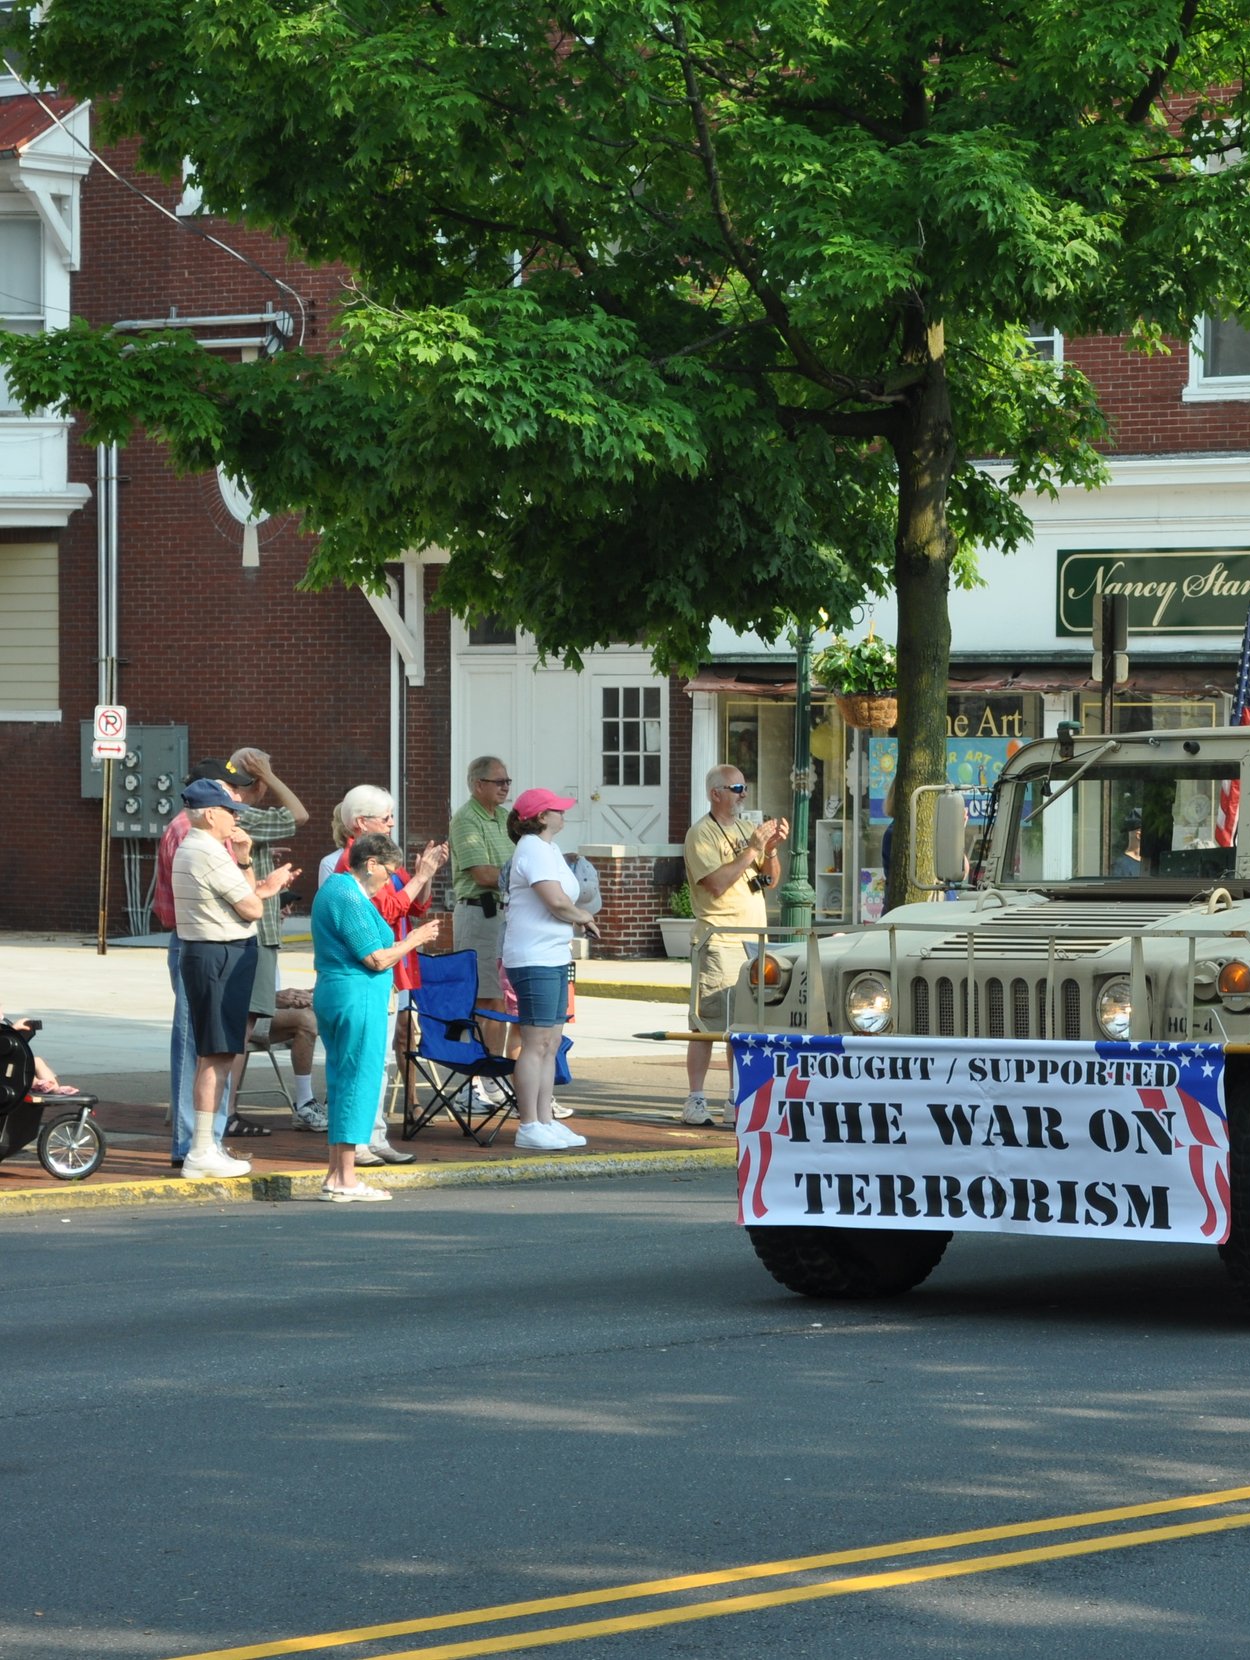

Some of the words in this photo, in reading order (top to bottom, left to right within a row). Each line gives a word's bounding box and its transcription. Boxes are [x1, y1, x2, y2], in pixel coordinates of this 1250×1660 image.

[1068, 561, 1178, 627] Nancy
[976, 705, 1023, 737] Art
[964, 750, 993, 764] ART
[773, 1054, 786, 1077] I
[798, 1055, 935, 1082] FOUGHT
[968, 1058, 1179, 1088] SUPPORTED
[778, 1100, 907, 1145] THE
[927, 1103, 1069, 1150] WAR
[1088, 1109, 1177, 1155] ON
[794, 1172, 1172, 1231] TERRORISM
